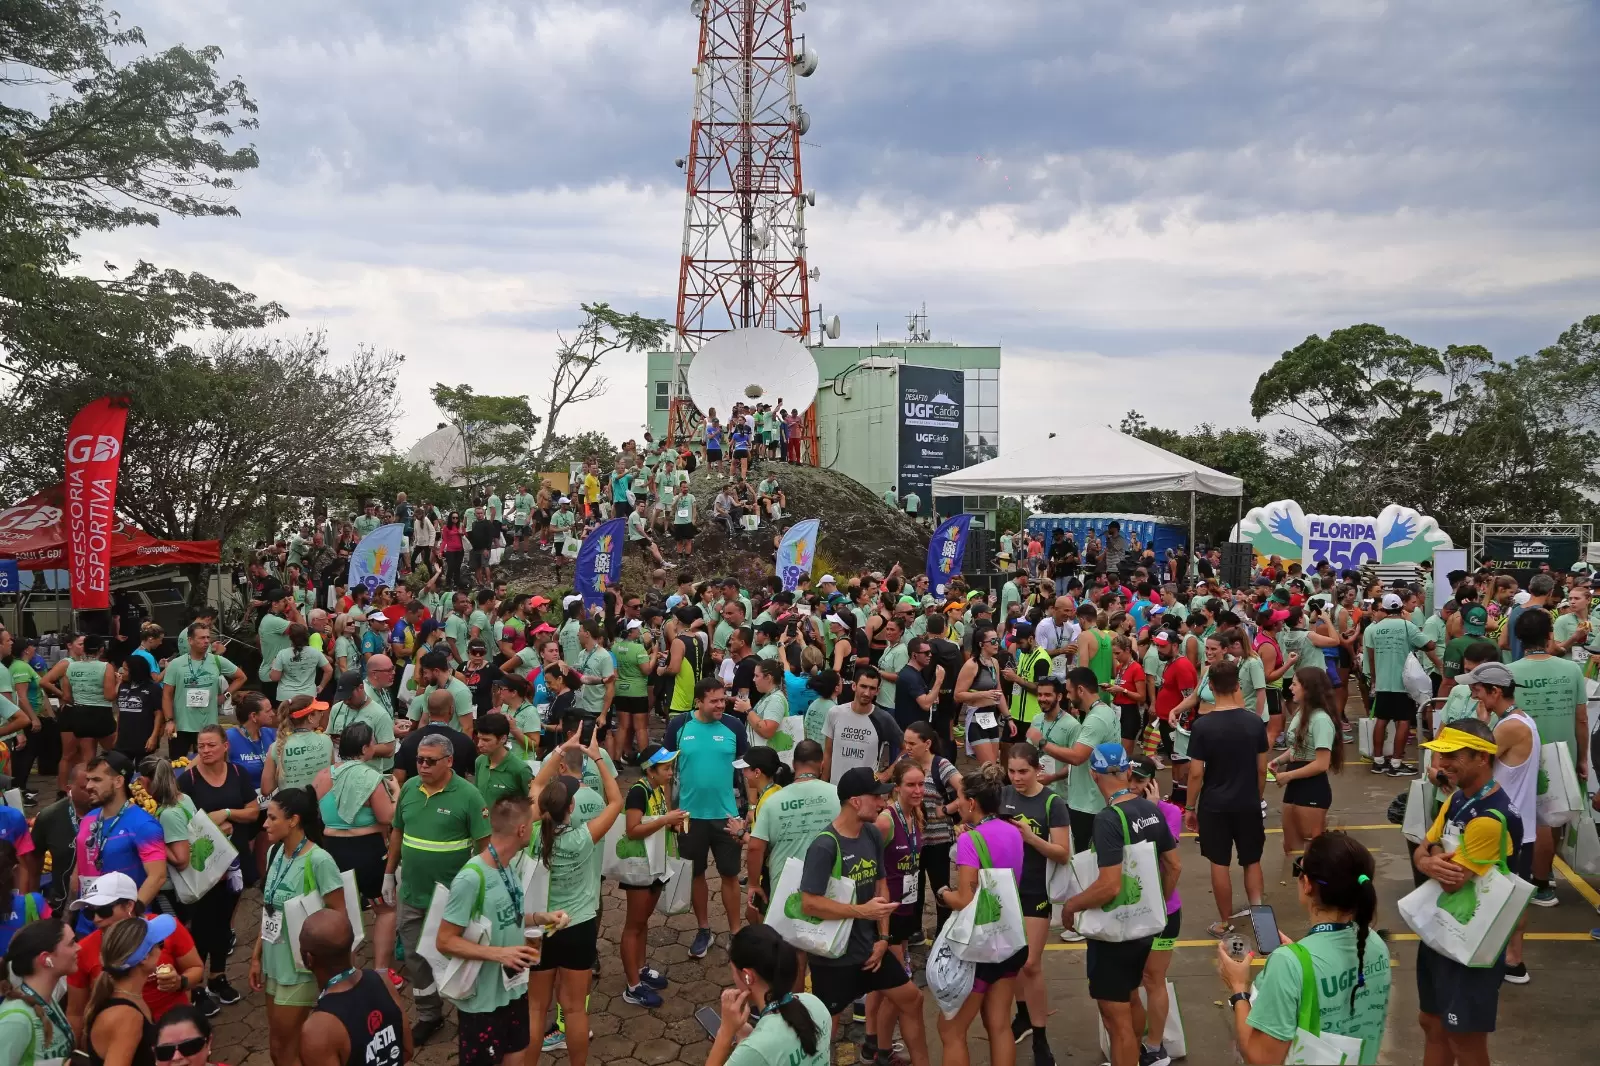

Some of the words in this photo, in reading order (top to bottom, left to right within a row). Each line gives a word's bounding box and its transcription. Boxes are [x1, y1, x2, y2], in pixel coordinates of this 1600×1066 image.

[905, 393, 928, 401] DESAFIO
[69, 469, 87, 594] ASSESSORIA
[89, 479, 112, 592] ESPORTIVA
[1309, 521, 1376, 540] FLORIPA
[47, 549, 62, 559] GD!
[1306, 539, 1377, 579] 350
[537, 683, 547, 692] Pa
[843, 726, 872, 736] ricardo
[841, 746, 865, 759] LUMIS
[265, 920, 279, 934] 905
[1315, 923, 1333, 932] UGF
